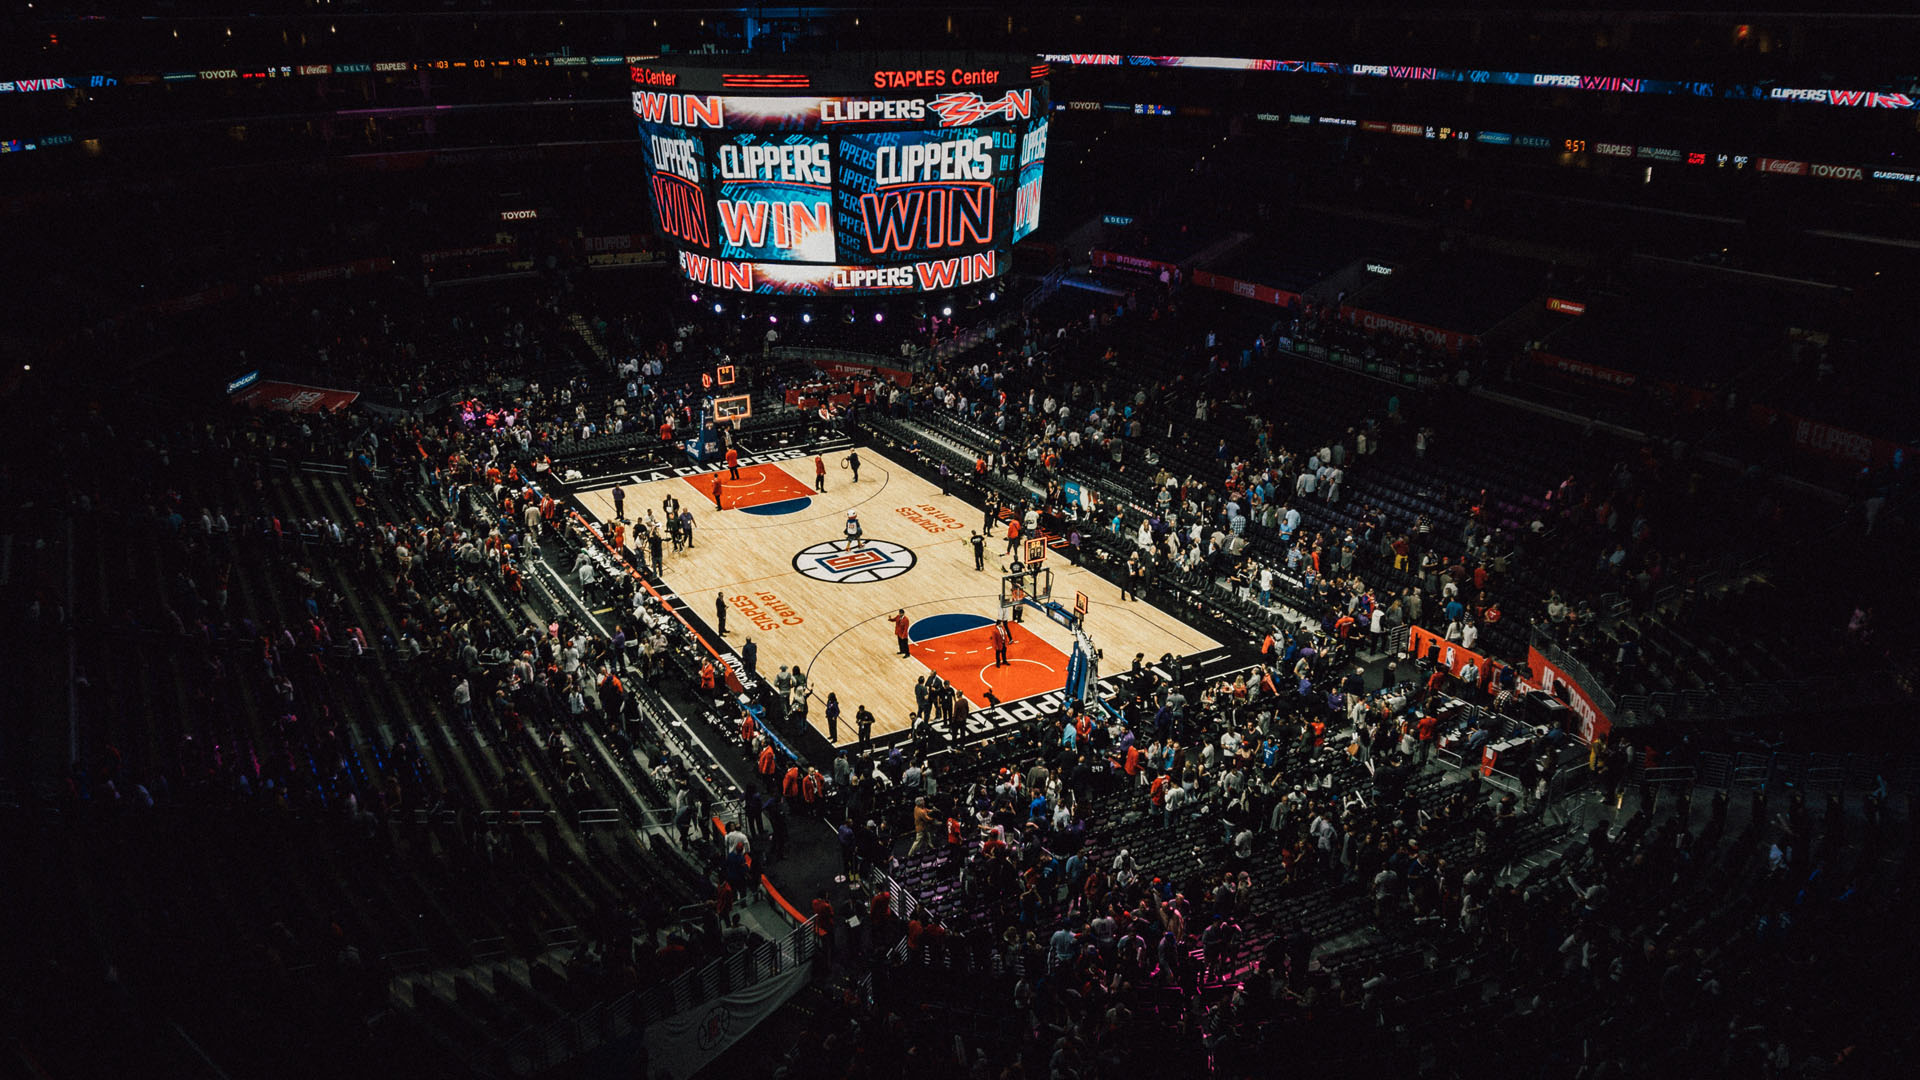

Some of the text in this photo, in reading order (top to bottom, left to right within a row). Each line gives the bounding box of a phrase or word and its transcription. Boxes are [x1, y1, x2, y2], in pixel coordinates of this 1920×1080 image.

[200, 69, 238, 79] TOYOTA
[375, 62, 407, 72] STAPLES
[1353, 64, 1388, 75] CLIPPERS
[1389, 66, 1436, 80] WIN
[16, 78, 65, 92] WIN
[645, 68, 677, 87] Center
[873, 68, 1000, 89] STAPLES Center
[1533, 74, 1580, 87] CLIPPERS
[1579, 75, 1640, 92] WIN
[1771, 87, 1827, 102] CLIPPERS
[640, 90, 724, 128] WIN
[820, 99, 925, 122] CLIPPERS
[1069, 101, 1101, 110] TOYOTA
[1257, 113, 1279, 121] verizon
[1392, 124, 1423, 134] TOSHIBA
[651, 134, 699, 184] CLIPPERS
[1596, 143, 1632, 156] STAPLES
[719, 142, 832, 184] CLIPPERS
[875, 135, 993, 185] CLIPPERS
[1810, 164, 1864, 180] TOYOTA
[501, 209, 537, 220] TOYOTA
[652, 175, 710, 248] WIN
[859, 184, 995, 254] WIN
[717, 199, 832, 249] WIN
[685, 251, 753, 292] WIN
[833, 266, 914, 288] CLIPPERS
[916, 249, 995, 291] WIN
[1366, 263, 1392, 275] verizon
[630, 471, 671, 484] LA
[895, 506, 946, 534] STAPLES
[915, 504, 964, 530] Center
[729, 595, 780, 632] STAPLES
[754, 591, 804, 626] Center
